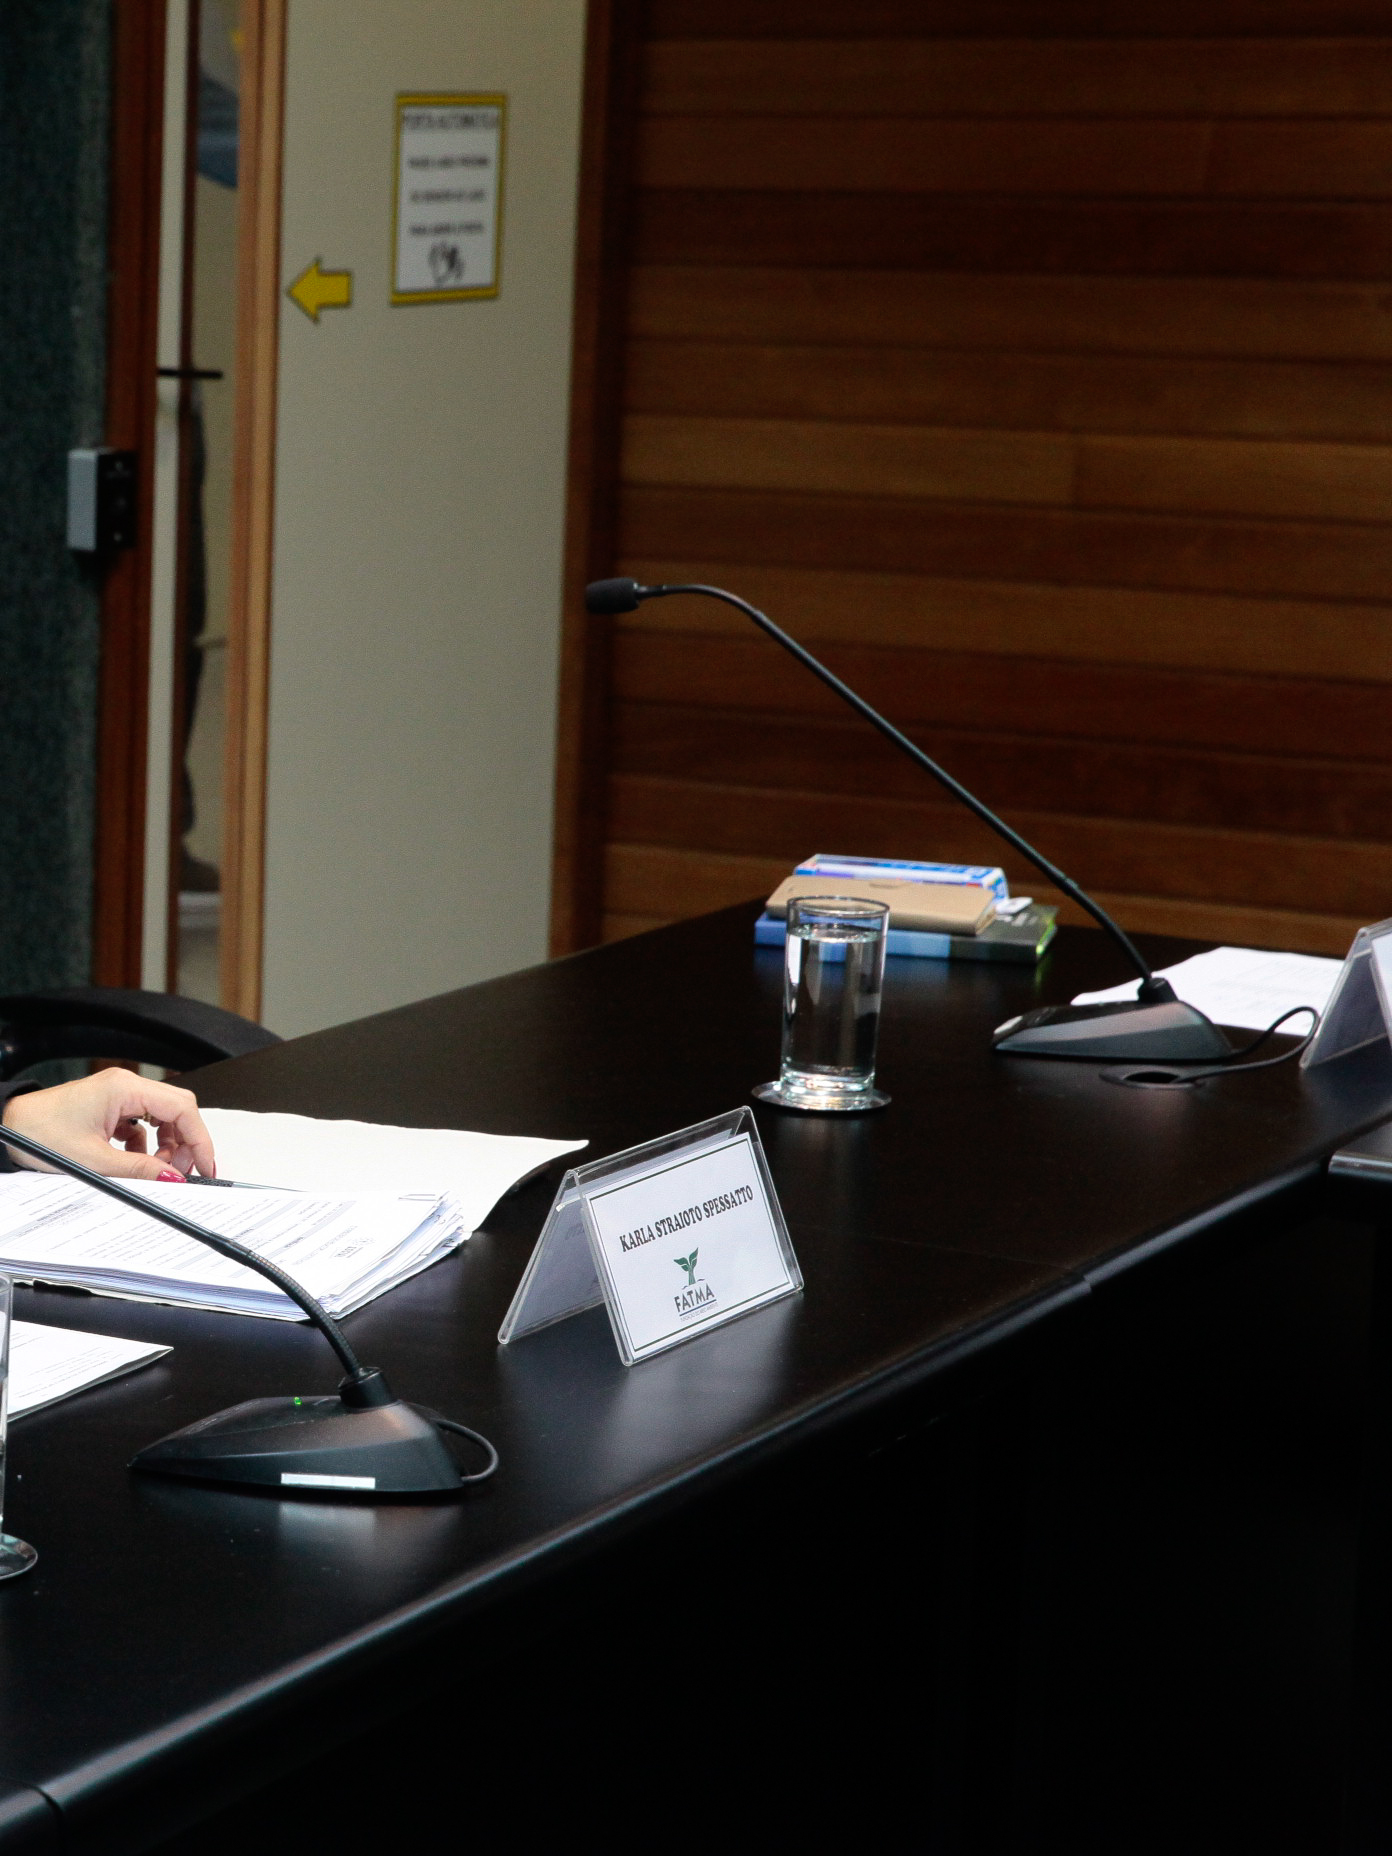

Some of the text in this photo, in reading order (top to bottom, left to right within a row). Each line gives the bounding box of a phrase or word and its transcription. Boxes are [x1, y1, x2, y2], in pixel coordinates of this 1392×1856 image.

[619, 1225, 656, 1252] KARLA
[654, 1205, 703, 1238] STRAIOTO
[702, 1185, 754, 1218] SPESSATTO
[674, 1283, 715, 1312] FATMA
